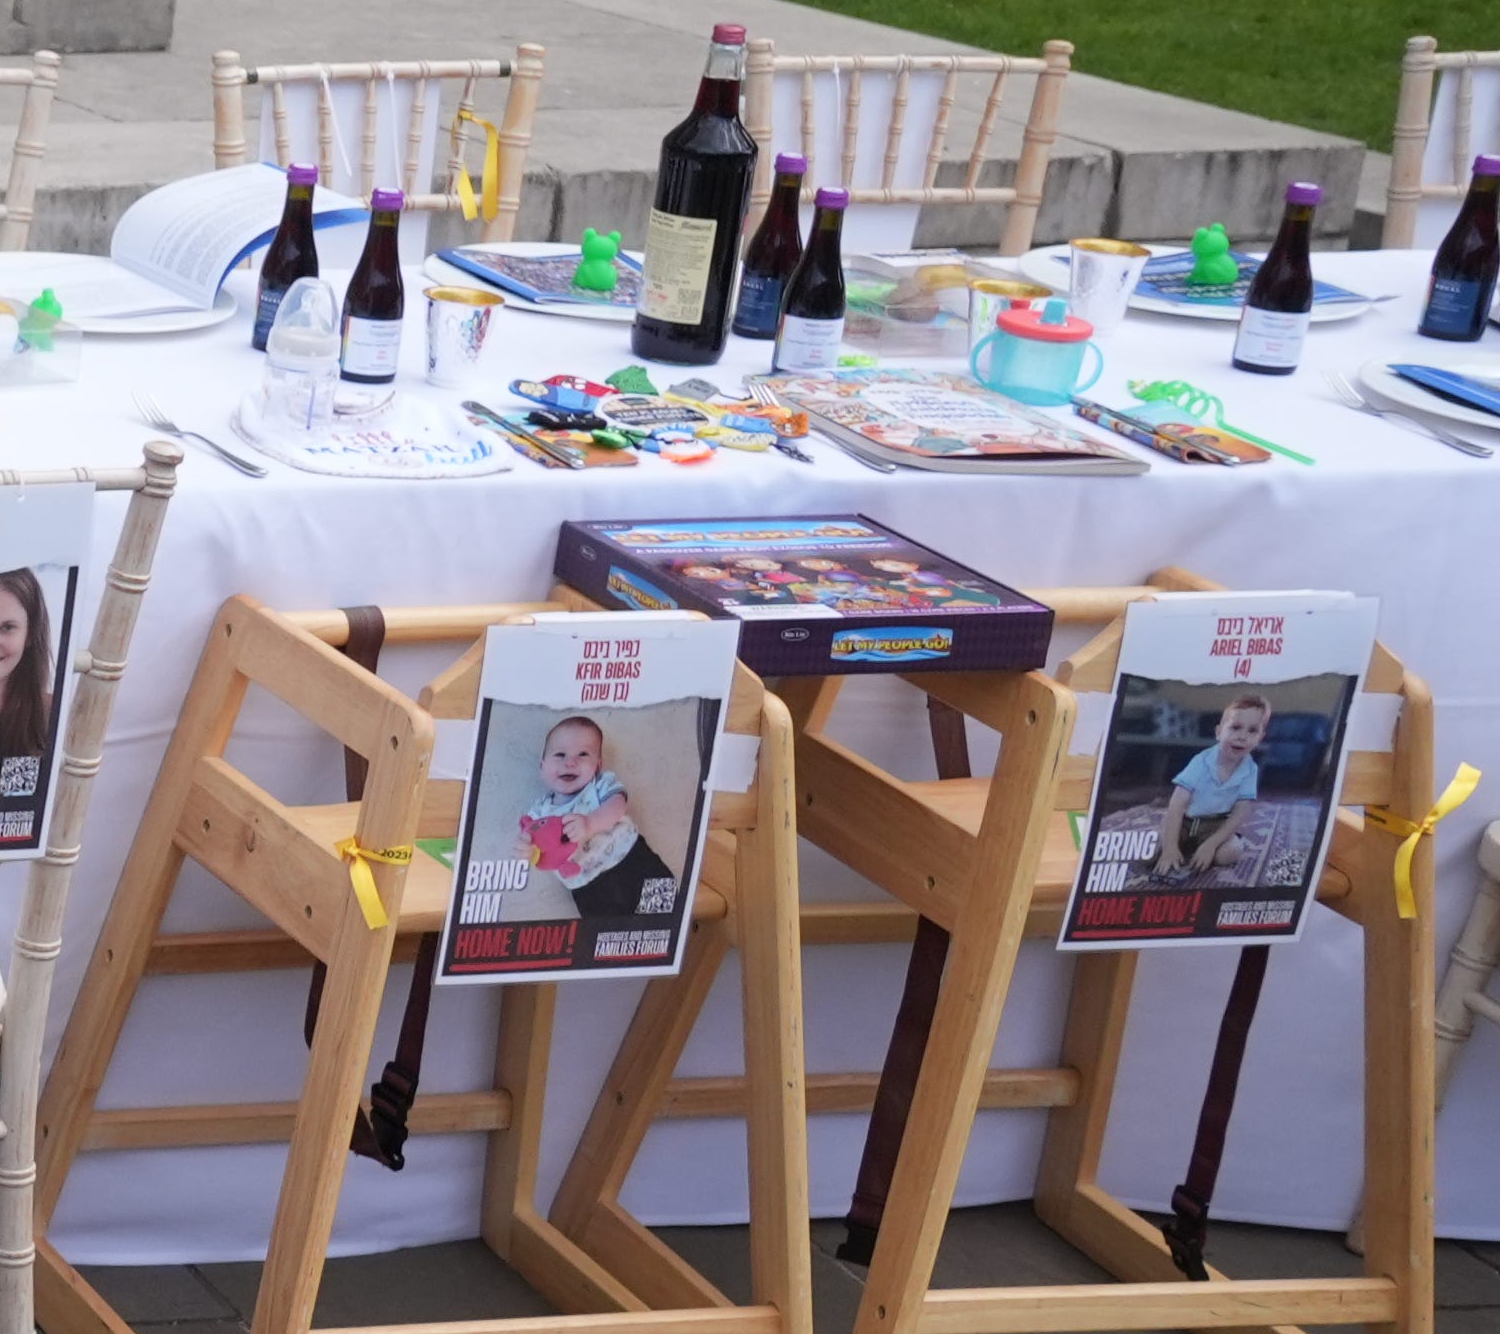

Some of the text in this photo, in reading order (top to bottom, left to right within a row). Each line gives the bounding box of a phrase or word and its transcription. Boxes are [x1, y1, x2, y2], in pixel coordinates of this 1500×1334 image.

[1217, 616, 1284, 636] אריאל ביבס
[583, 639, 640, 659] כפיר ביבס
[833, 639, 854, 652] LET
[854, 639, 878, 652] MY
[877, 638, 925, 651] PEOPLE
[1210, 637, 1283, 656] ARIEL BIBAS
[575, 661, 641, 680] KFIR BIBAS
[1234, 657, 1251, 679] (4)
[1092, 831, 1158, 862] BRING
[465, 859, 530, 892] BRING
[1085, 862, 1129, 893] HIM
[459, 892, 501, 925] HIM
[1077, 897, 1139, 925] HOME
[1216, 910, 1293, 926] FAMILIES FORUM
[454, 928, 514, 959] HOME
[594, 939, 669, 957] FAMILIES FORUM
